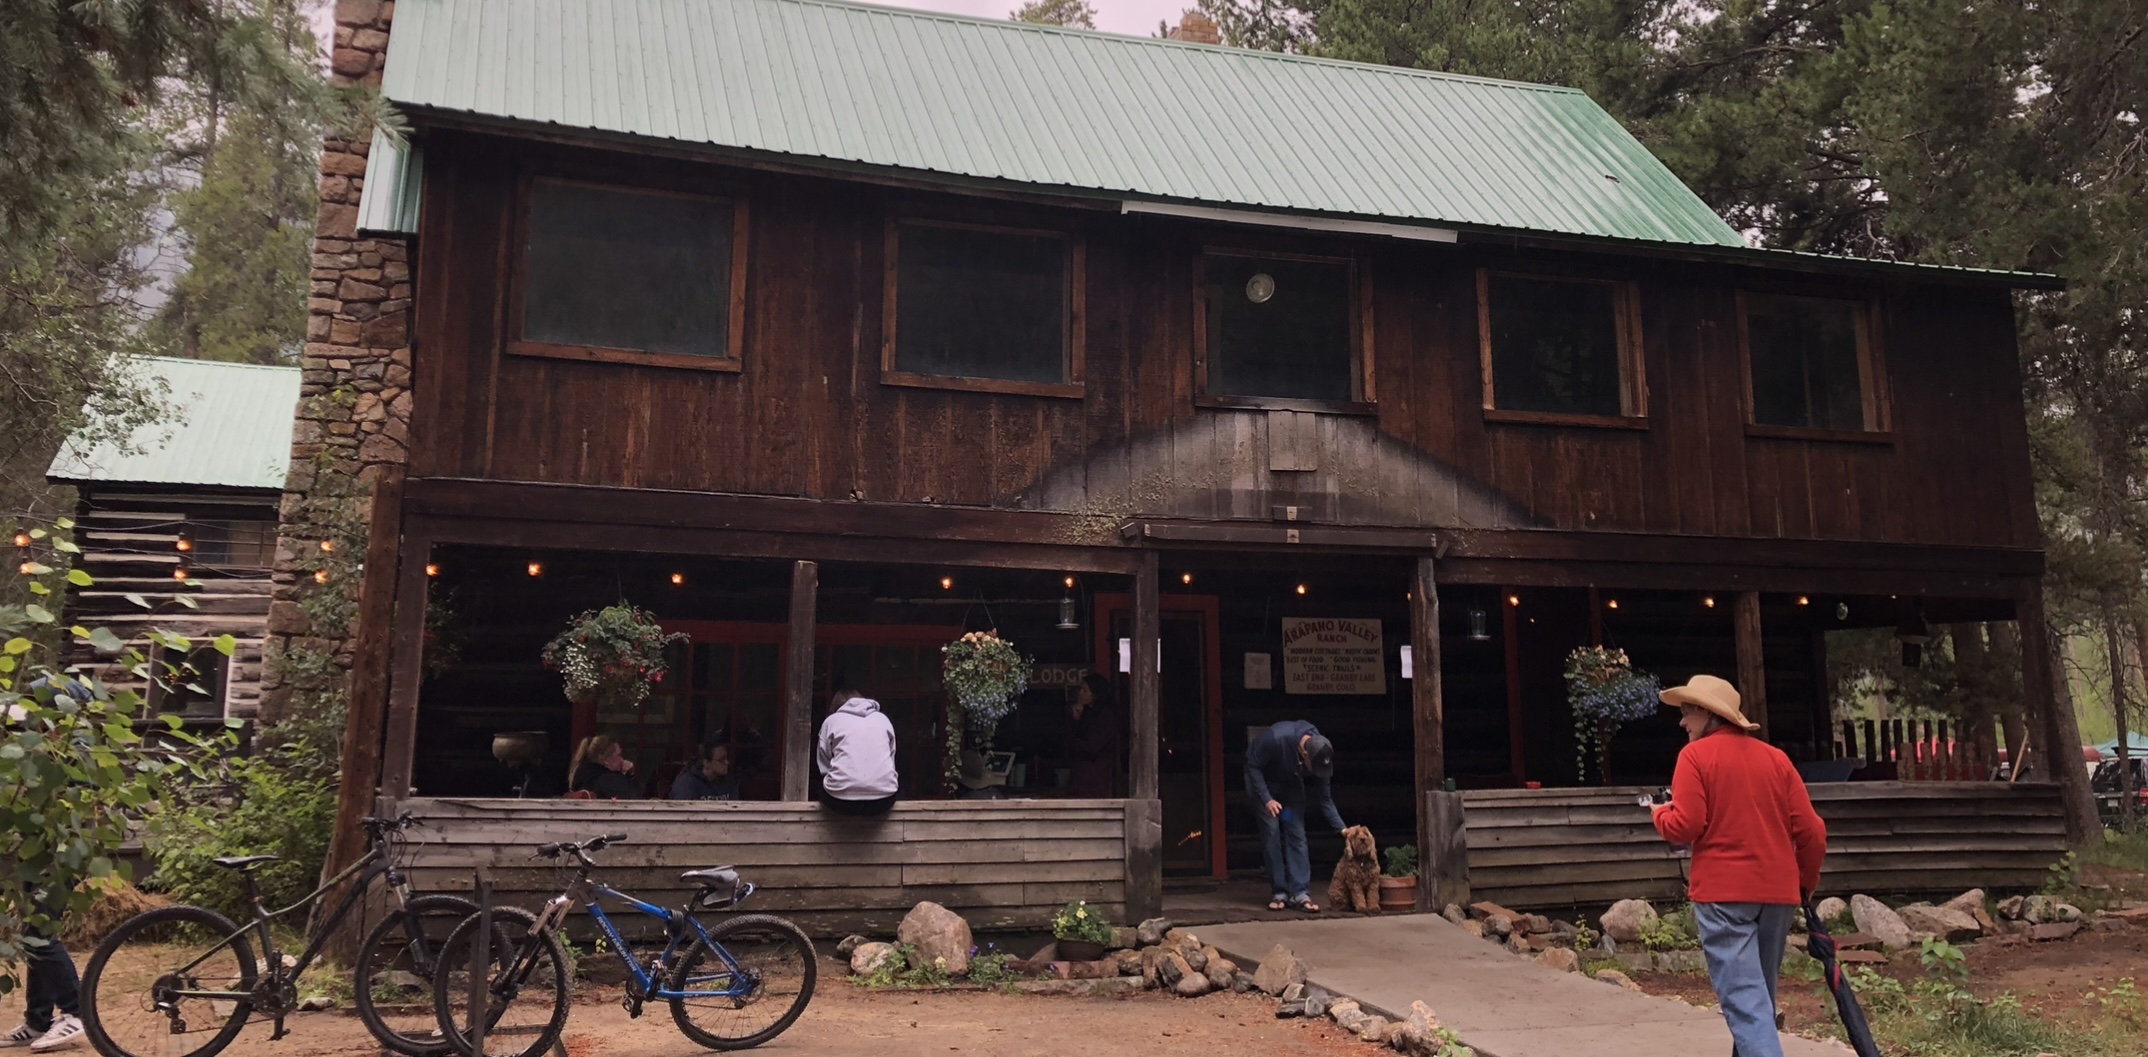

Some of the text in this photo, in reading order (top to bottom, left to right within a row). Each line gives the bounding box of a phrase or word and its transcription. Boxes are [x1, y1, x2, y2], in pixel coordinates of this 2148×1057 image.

[1283, 620, 1378, 648] ARAPAHO VALLEY
[1317, 633, 1347, 643] RANCH
[1334, 656, 1350, 664] GOOD
[1307, 664, 1355, 672] SCENIC TRAILS
[1293, 673, 1309, 681] EAST
[1312, 673, 1325, 682] END
[1330, 673, 1358, 682] GRANBY
[1360, 673, 1376, 682] LAKE
